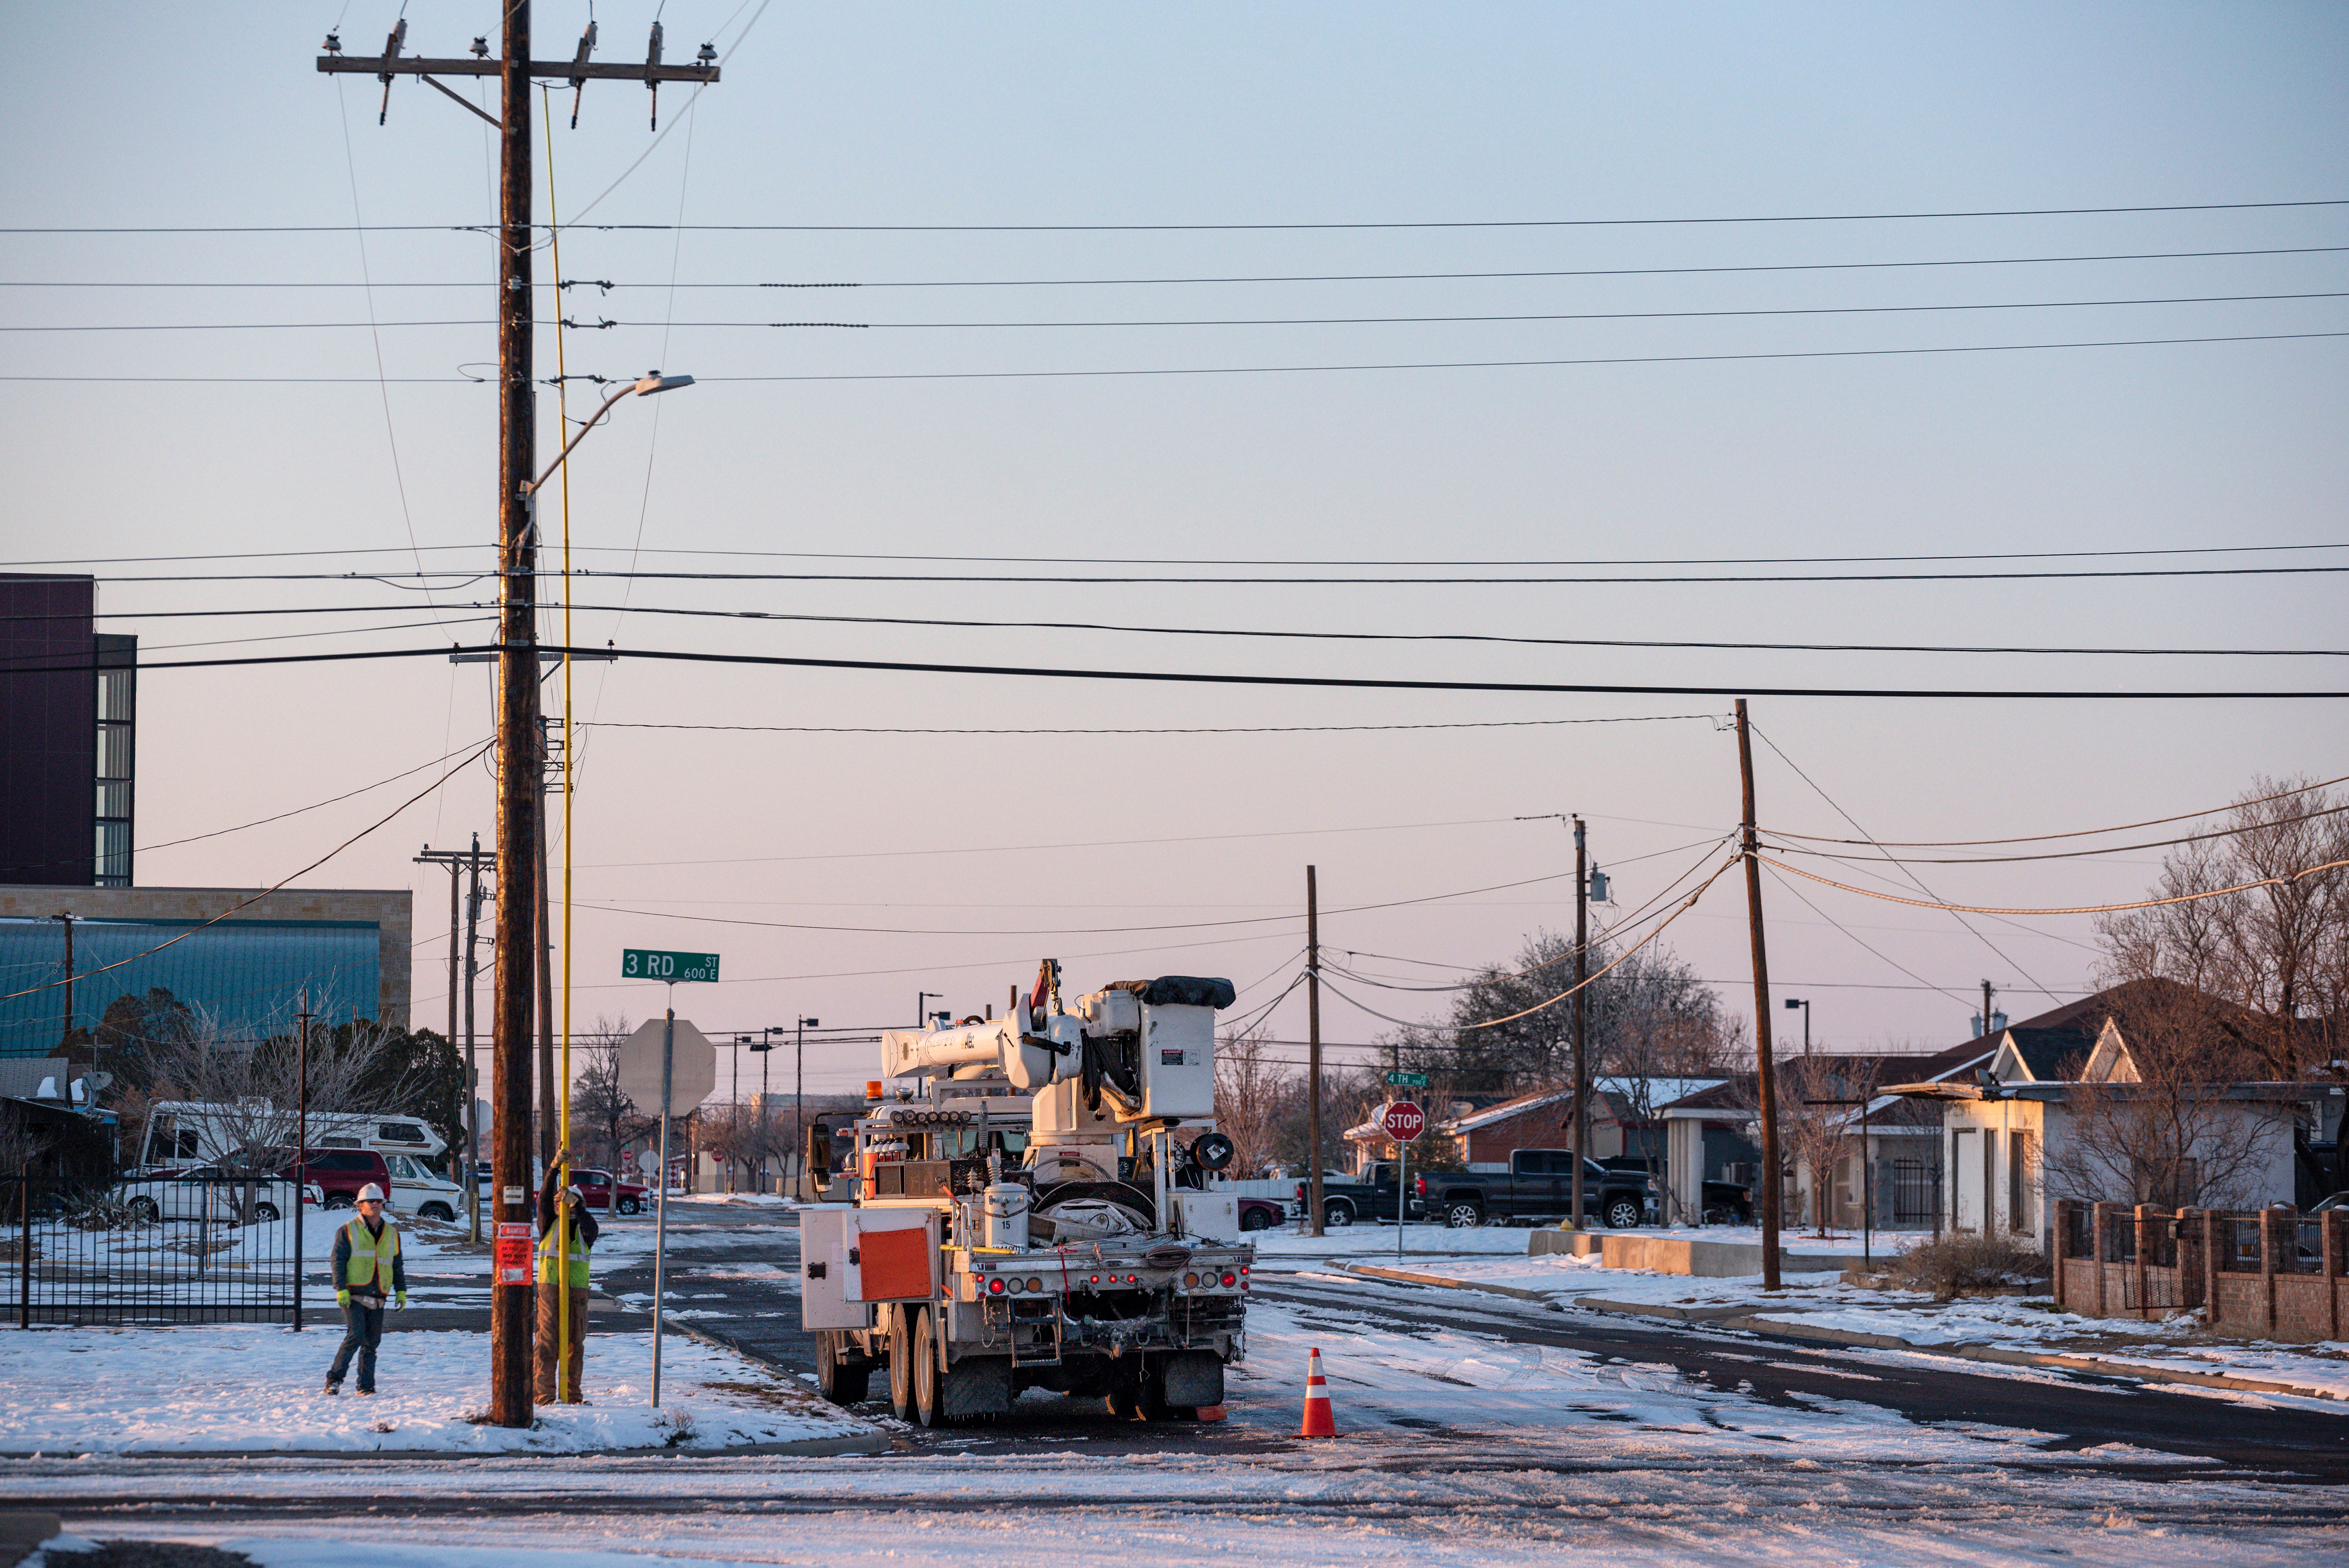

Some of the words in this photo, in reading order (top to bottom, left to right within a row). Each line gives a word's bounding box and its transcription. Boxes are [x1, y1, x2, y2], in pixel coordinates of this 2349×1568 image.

[626, 953, 638, 974] 3
[647, 955, 674, 976] RD
[705, 957, 717, 968] ST
[684, 968, 706, 979] 600
[710, 969, 716, 980] E
[1388, 1074, 1394, 1082] 4
[1398, 1074, 1408, 1083] TH
[1387, 1114, 1421, 1129] STOP
[1002, 1221, 1010, 1229] 15
